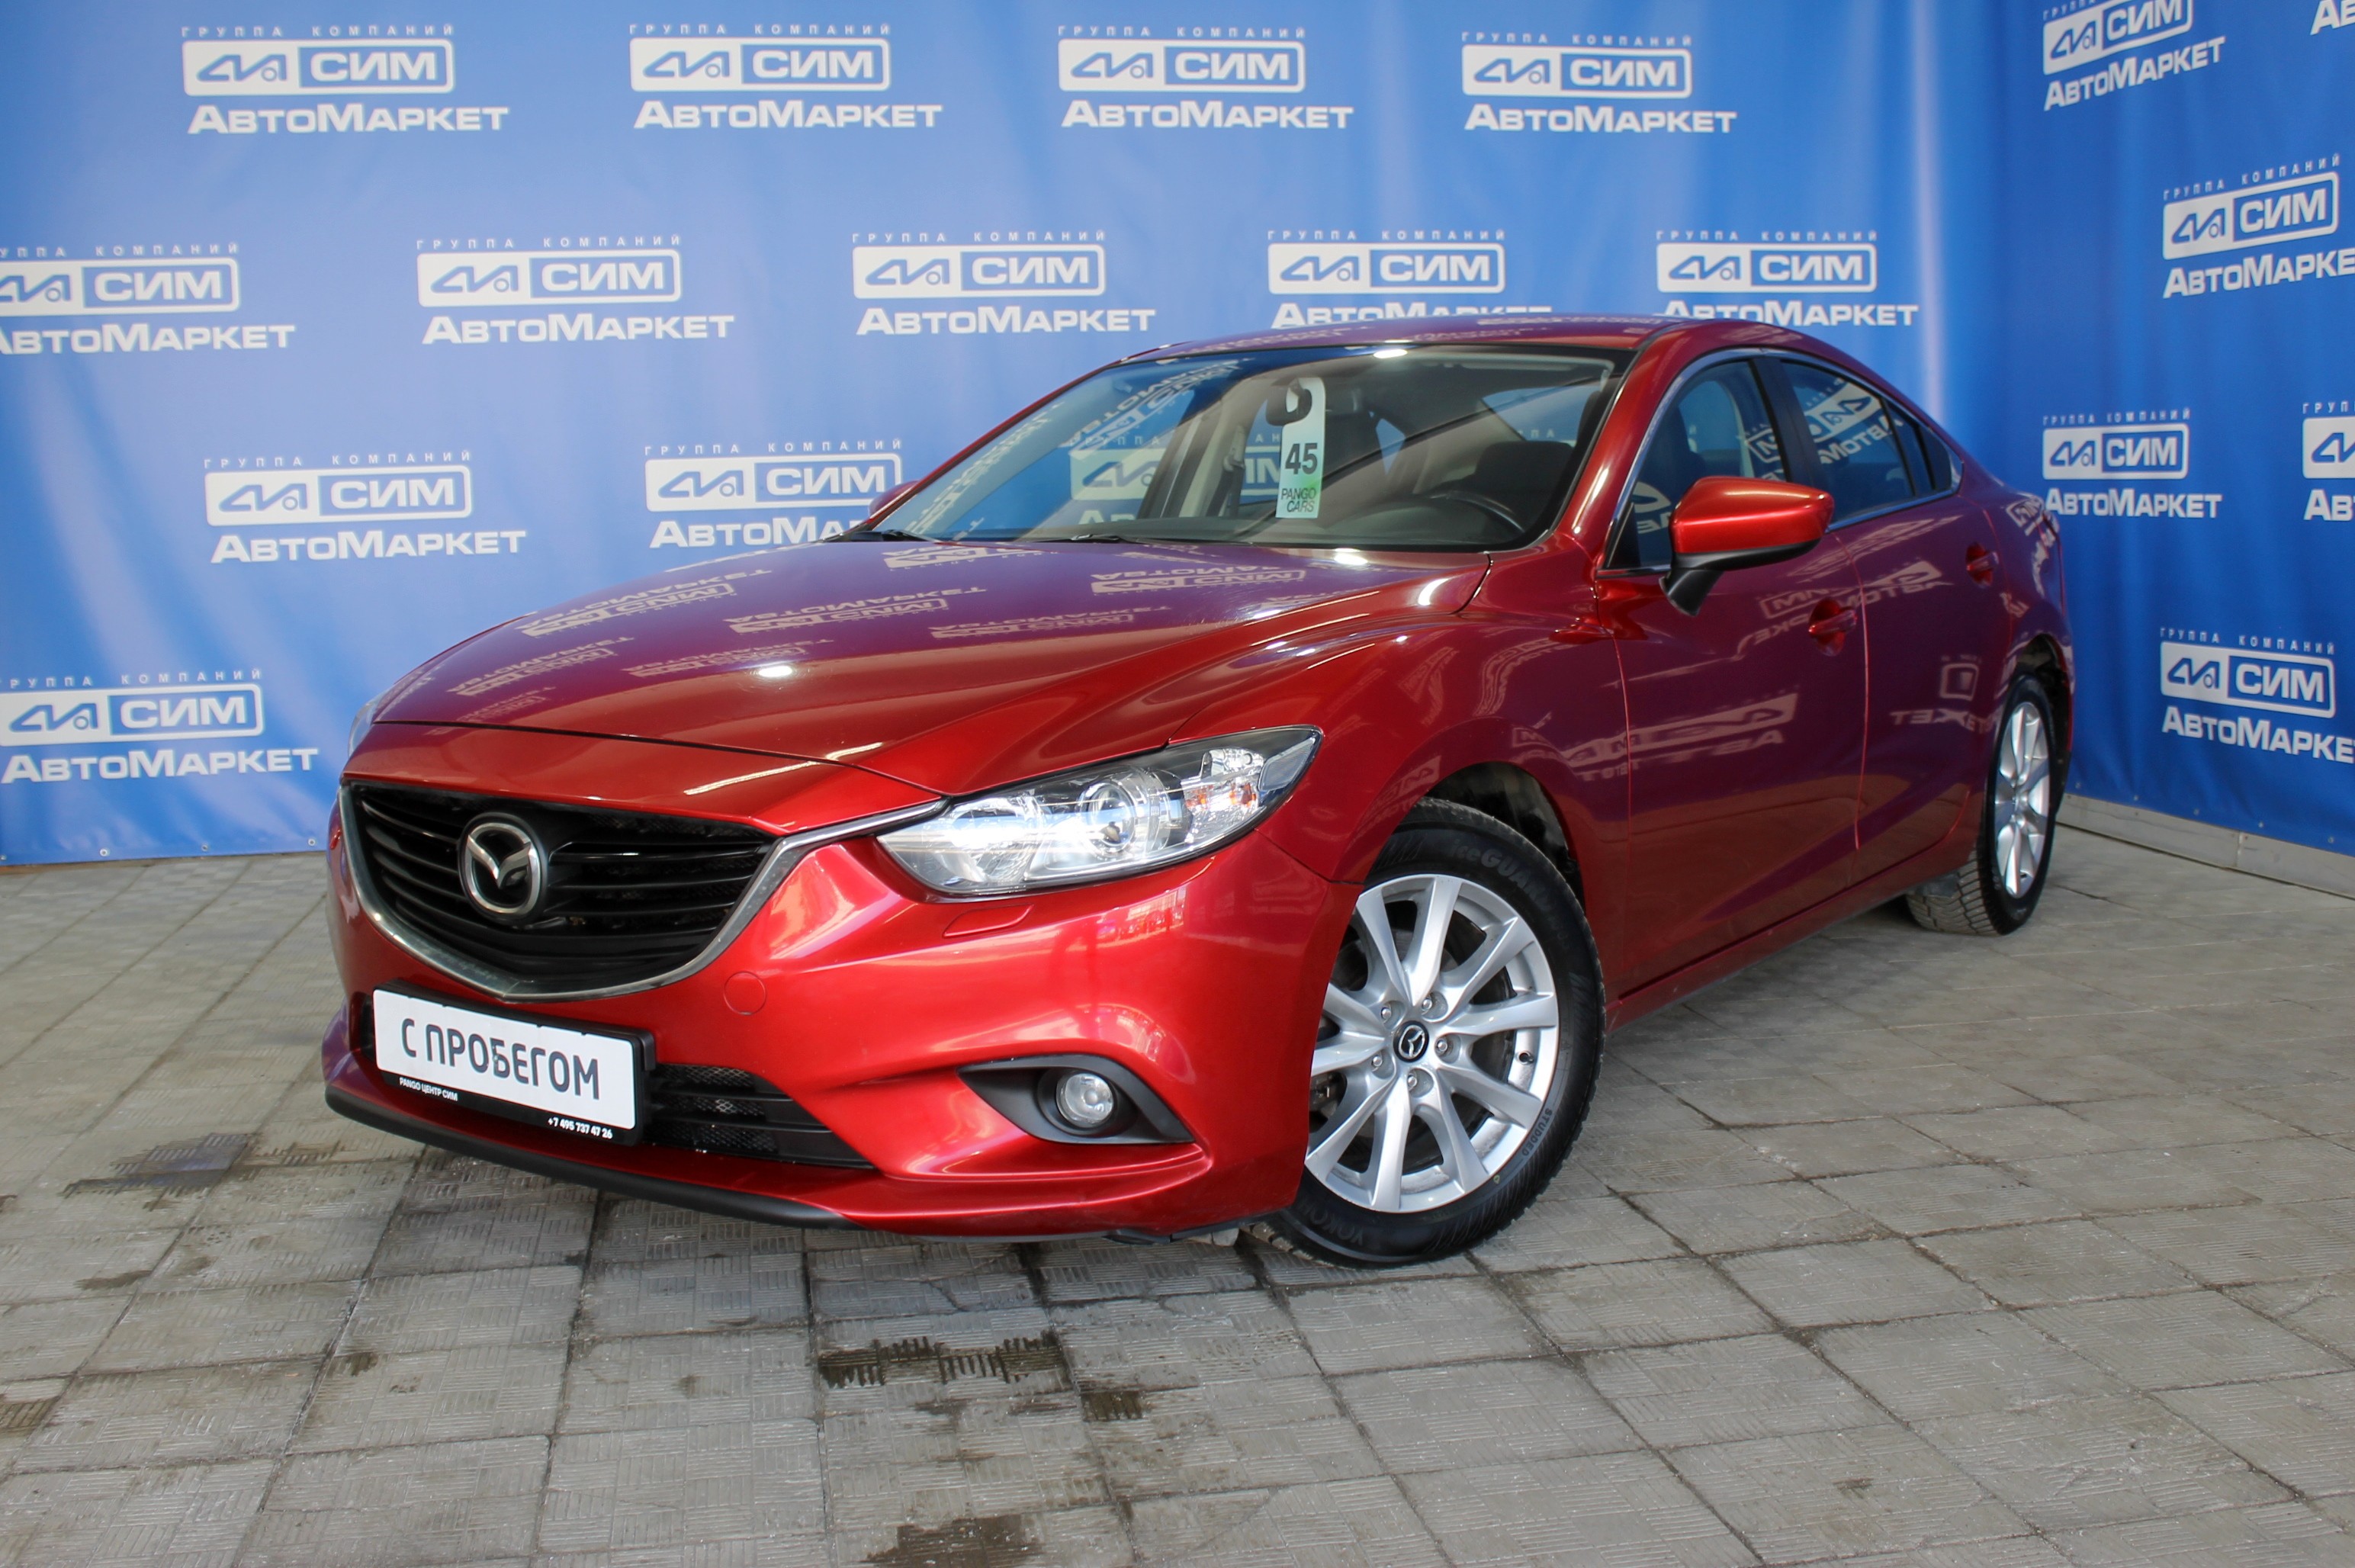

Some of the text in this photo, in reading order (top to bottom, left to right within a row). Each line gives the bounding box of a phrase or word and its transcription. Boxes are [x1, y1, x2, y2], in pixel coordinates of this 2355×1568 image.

[182, 24, 452, 37] ГРУППА КОМПАНИЙ
[630, 24, 889, 34] ГРУППА КОМПАНИЙ
[1059, 26, 1304, 37] ГРУППА КОМПАНИЙ
[2108, 0, 2182, 40] СИМ
[1463, 32, 1692, 45] ГРУППА КОМПАНИЙ
[311, 52, 435, 80] СИМ
[753, 50, 872, 78] СИМ
[1175, 52, 1289, 79] СИМ
[1571, 59, 1676, 86] СИМ
[2164, 155, 2339, 200] ГРУППА КОМПАНИЙ
[2241, 188, 2326, 232] СИМ
[417, 235, 679, 249] ГРУППА КОМПАНИЙ
[853, 230, 1104, 243] ГРУППА КОМПАНИЙ
[1268, 230, 1504, 240] ГРУППА КОМПАНИЙ
[1656, 230, 1876, 240] ГРУППА КОМПАНИЙ
[0, 243, 238, 257] УППА КОМПАНИЙ
[542, 262, 663, 291] СИМ
[972, 257, 1088, 284] СИМ
[1380, 255, 1489, 281] СИМ
[1760, 255, 1862, 280] СИМ
[2164, 248, 2355, 297] АвтоМарке
[95, 271, 221, 300] СИМ
[2044, 408, 2190, 423] ГРУППА КОМПАНИЙ
[2303, 400, 2355, 413] ГРУП
[204, 451, 469, 468] ГРУППА КОМПАНИЙ
[645, 439, 900, 455] ГРУППА КОМПАНИЙ
[1285, 442, 1318, 475] 45
[2107, 437, 2177, 466] СИМ
[331, 478, 454, 509] СИМ
[766, 466, 885, 495] СИМ
[1281, 488, 1316, 500] PANGO
[1287, 500, 1315, 512] CARS
[650, 516, 862, 548] АвтоМа
[2161, 628, 2334, 654] ГРУППА КОМПАНИЙ
[0, 669, 261, 688] РУППА КОМПАНИЙ
[2237, 664, 2324, 702] СИМ
[121, 697, 245, 728] СИМ
[2164, 707, 2355, 763] АвтоМарке
[401, 1017, 600, 1101] С ПРОБЕГОМ
[399, 1077, 458, 1101] PANGO ЦЕНТР СИМ
[548, 1117, 613, 1139] +7 495 737 47 26
[1521, 1107, 1553, 1157] STUDDED
